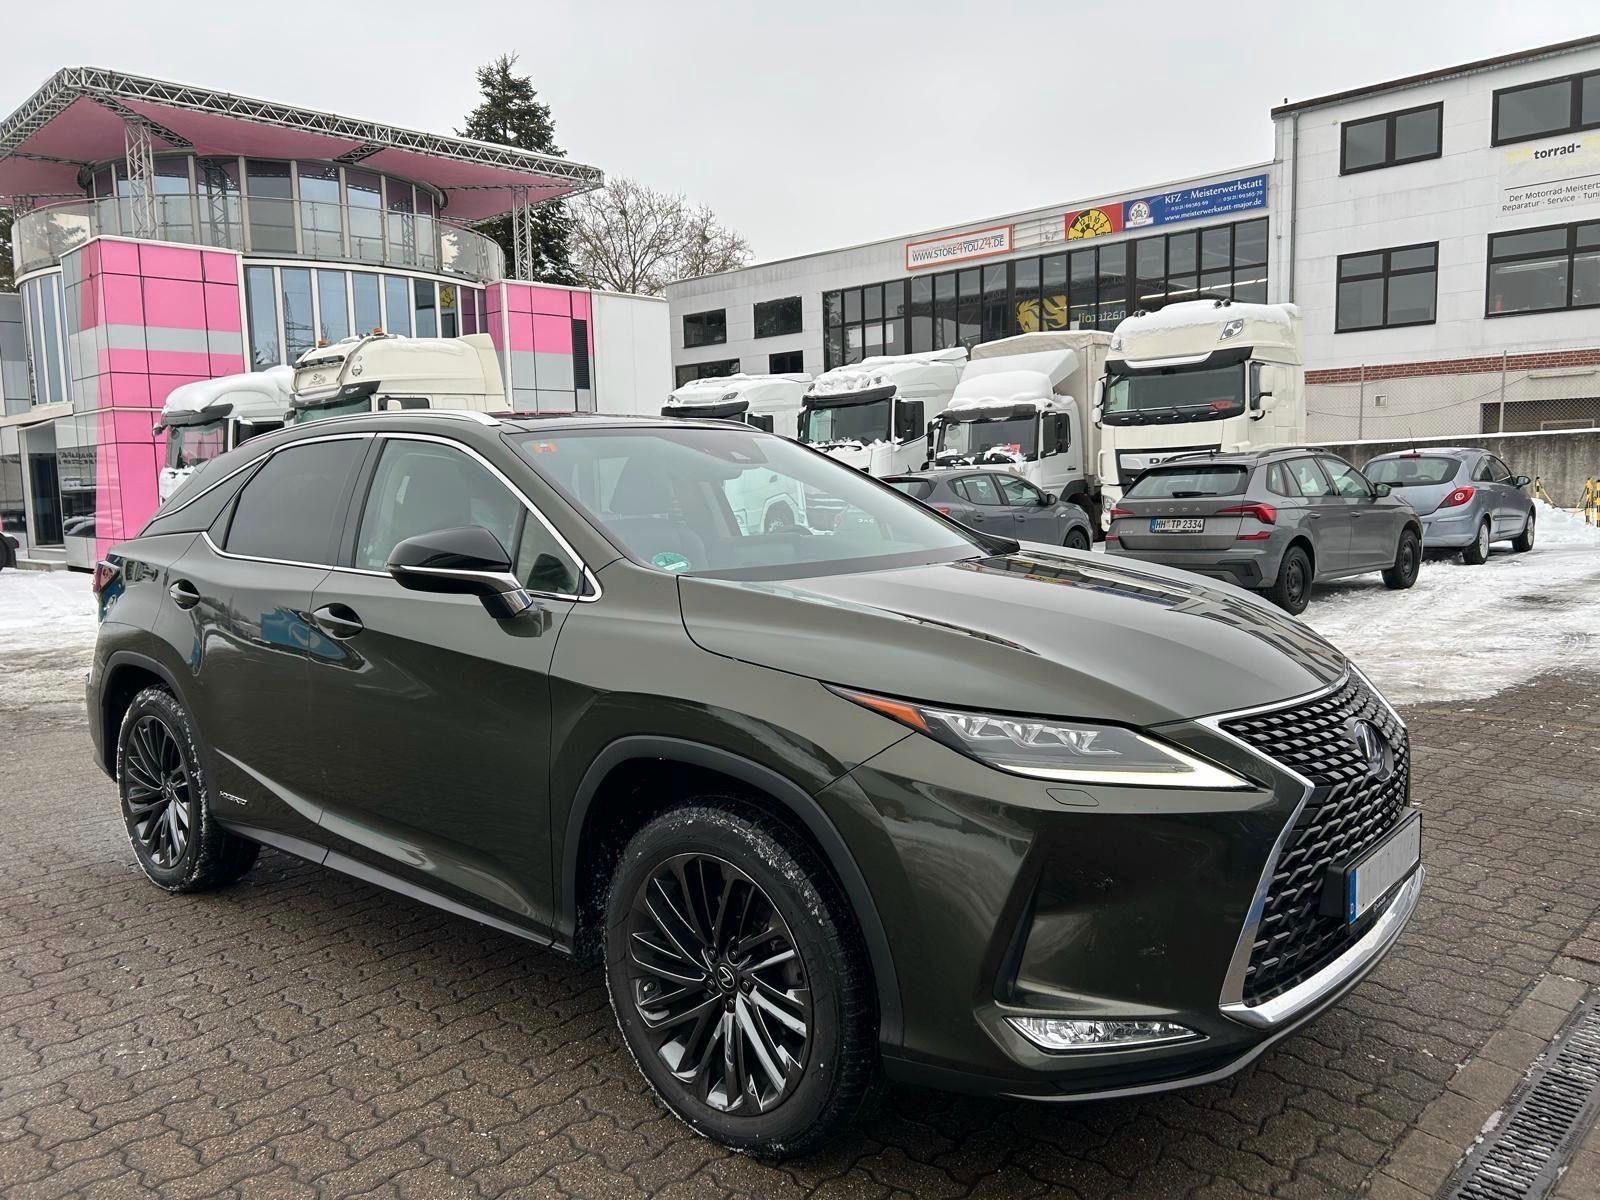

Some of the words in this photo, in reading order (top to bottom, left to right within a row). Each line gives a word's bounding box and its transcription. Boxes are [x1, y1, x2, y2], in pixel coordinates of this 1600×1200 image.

[1164, 193, 1181, 204] KFZ
[1190, 179, 1262, 200] Meisterwerkstatt
[1509, 194, 1523, 202] Der
[1164, 198, 1262, 222] www.meisterwerkstatt-major.de
[1502, 200, 1540, 212] Reparatur
[1547, 195, 1575, 205] Service
[912, 236, 1005, 262] WWW.STORE4YOU24.DE
[1155, 519, 1166, 529] HH
[1171, 519, 1182, 529] TP
[1182, 519, 1202, 529] 2334
